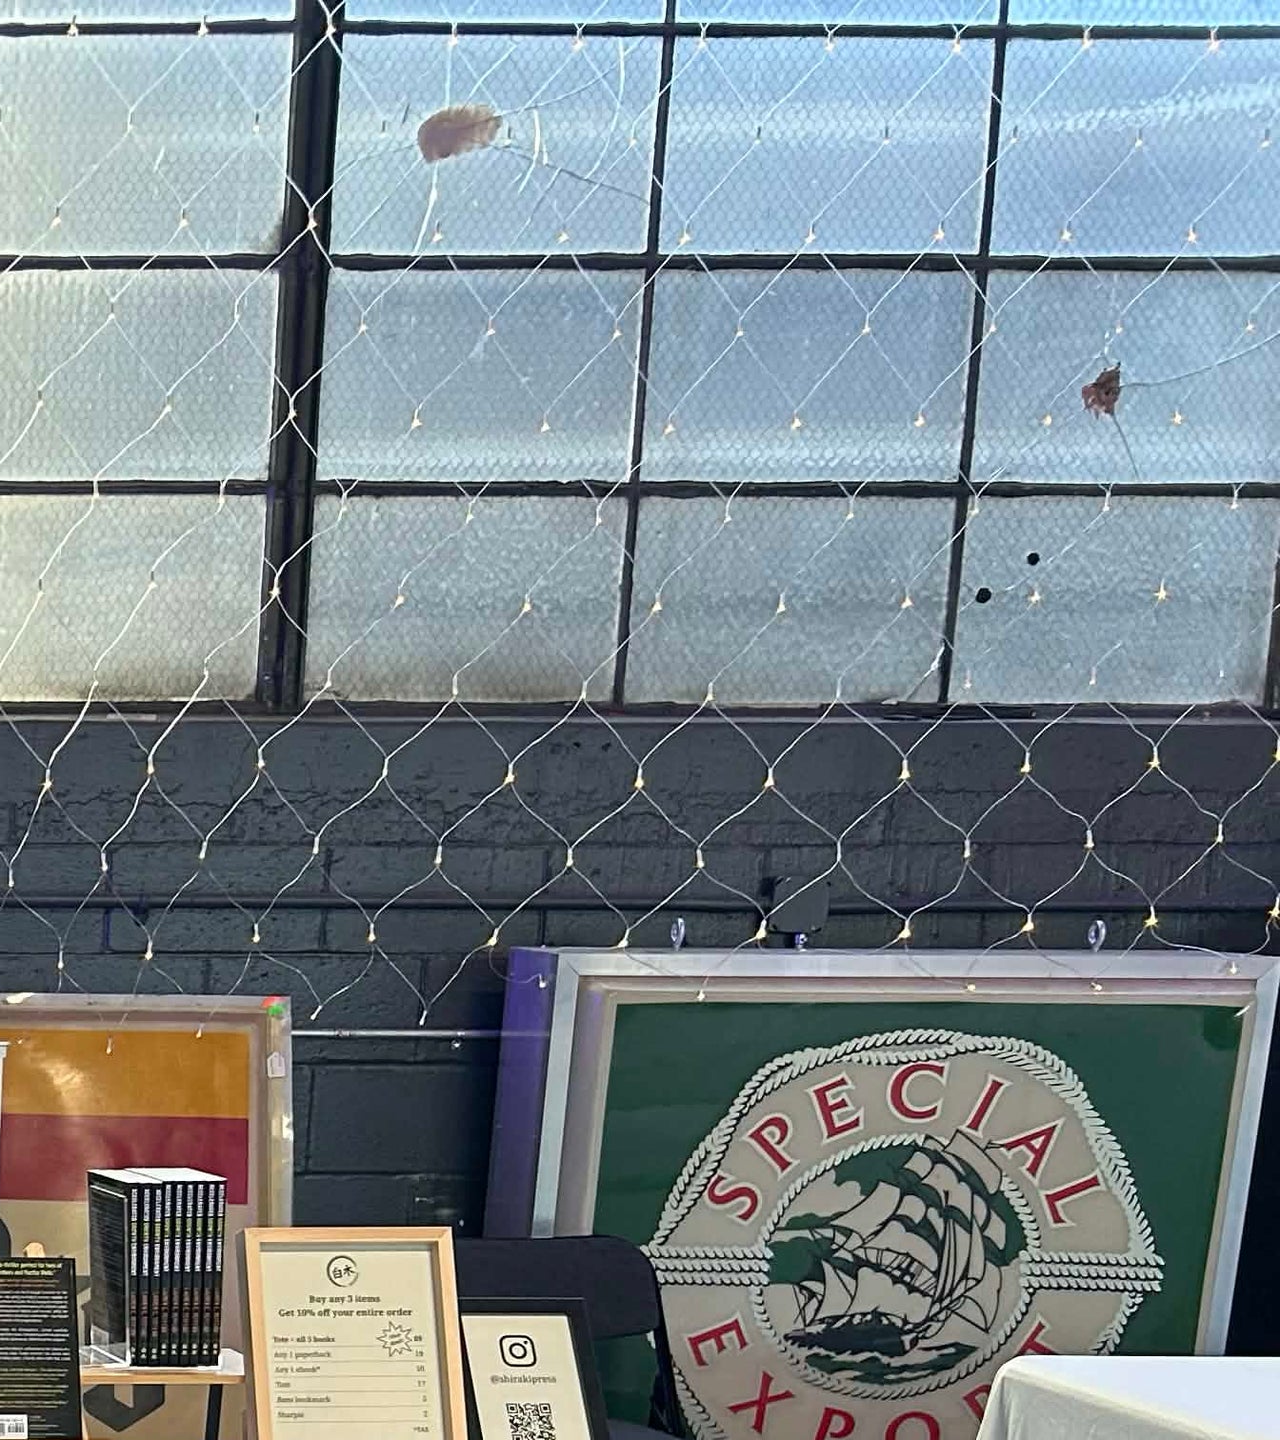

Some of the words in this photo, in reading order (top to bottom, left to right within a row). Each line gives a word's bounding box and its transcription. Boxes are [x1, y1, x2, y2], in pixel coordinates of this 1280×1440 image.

[706, 1060, 1102, 1226] SPECIAL
[331, 1264, 356, 1279] 白木
[309, 1295, 326, 1304] Buy
[329, 1296, 345, 1304] any
[347, 1295, 353, 1303] 3
[355, 1295, 381, 1303] items
[278, 1309, 294, 1317] Get
[297, 1309, 315, 1317] 10%
[332, 1310, 355, 1318] your
[386, 1308, 413, 1316] order
[490, 1374, 557, 1385] @shirakipress
